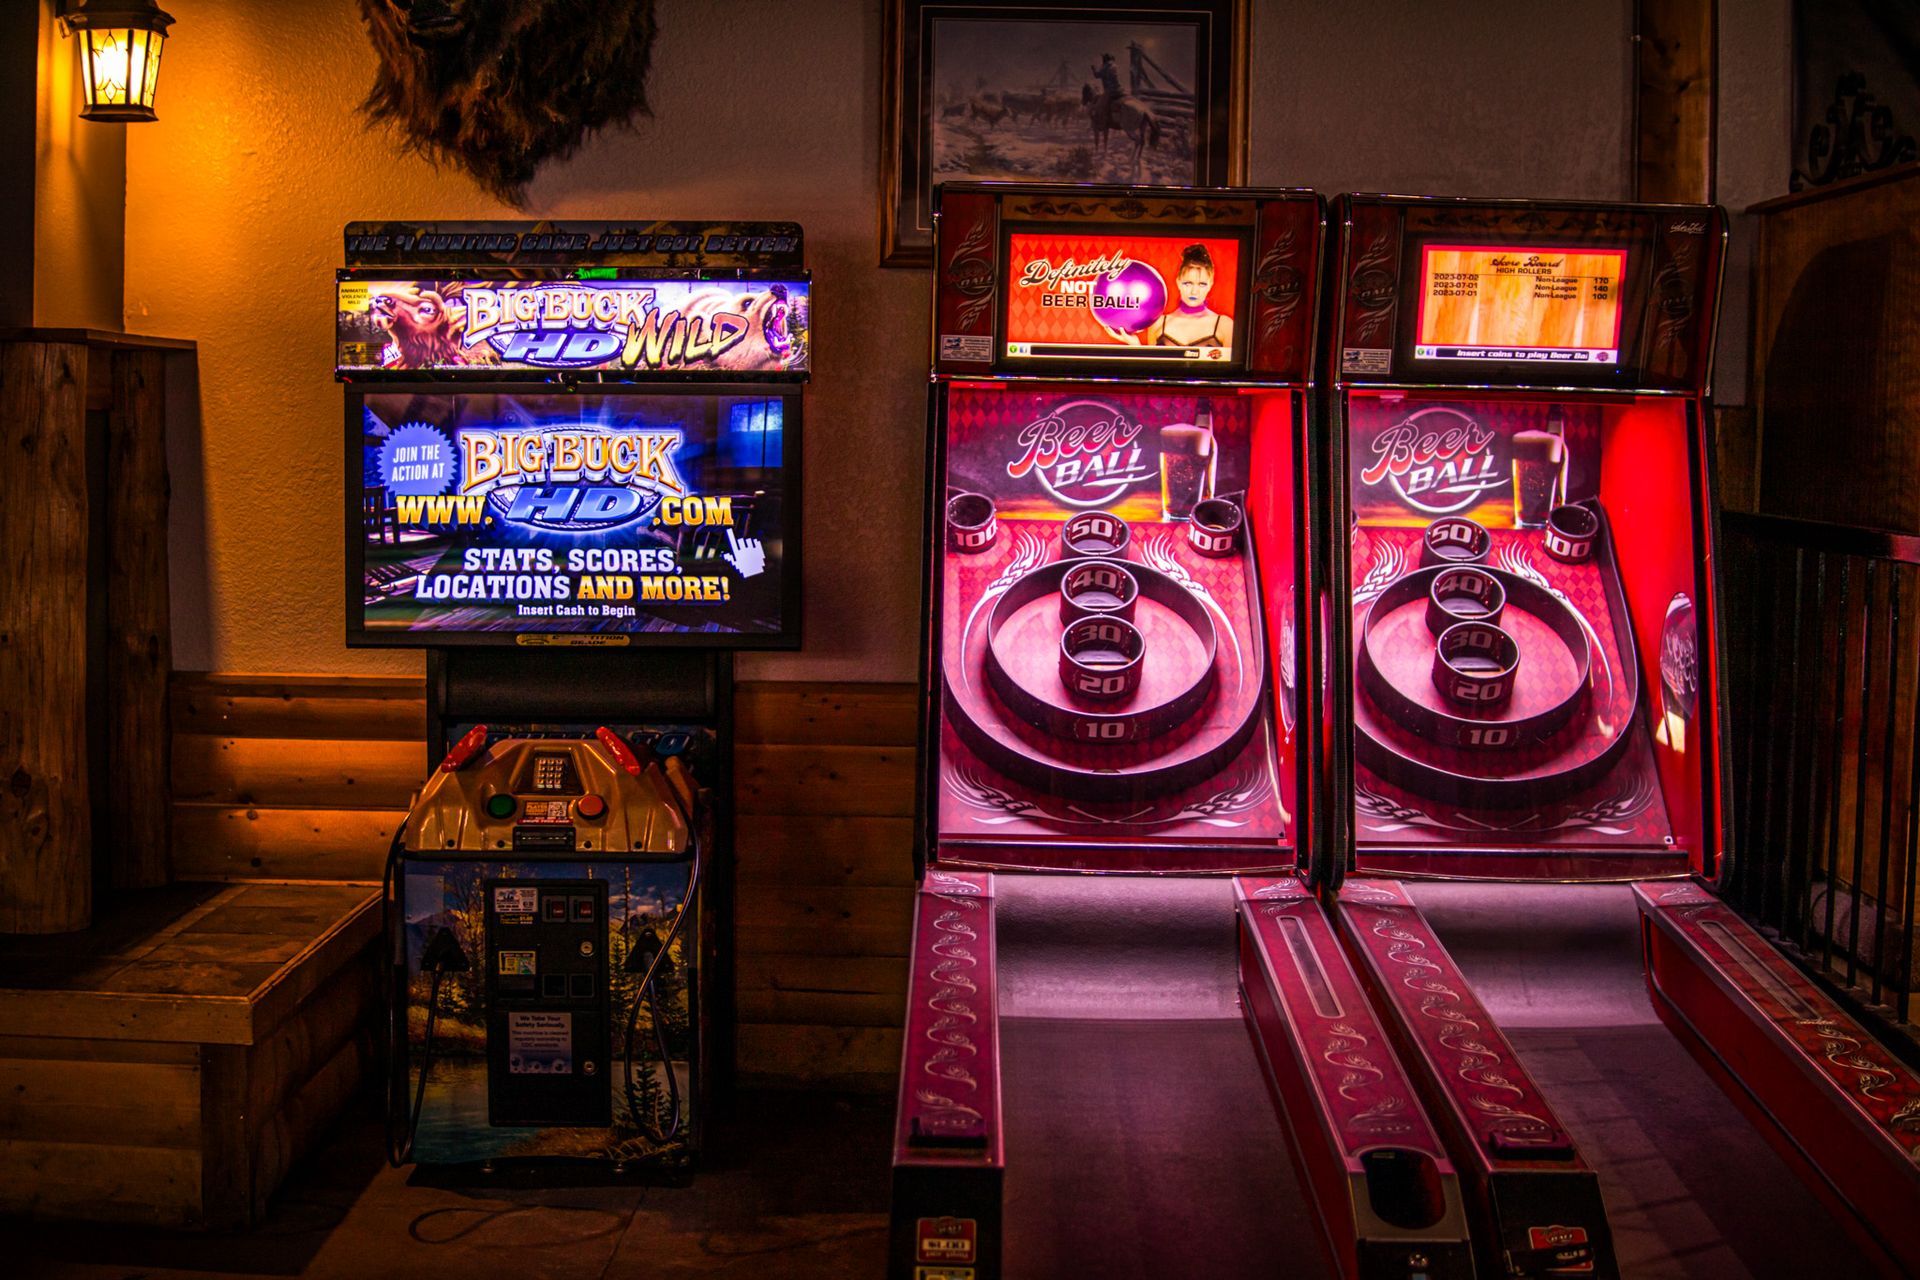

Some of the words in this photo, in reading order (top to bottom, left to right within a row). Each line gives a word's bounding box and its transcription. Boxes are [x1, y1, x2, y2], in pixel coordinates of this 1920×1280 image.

[349, 235, 390, 251] THE
[418, 235, 517, 251] HUNTING
[521, 235, 588, 251] GAME
[591, 235, 651, 251] JUST
[655, 235, 704, 251] GOT
[705, 235, 800, 252] BETTER!
[1020, 248, 1130, 290] Definitely
[1495, 267, 1516, 275] HIGH
[1060, 280, 1098, 294] NOT
[1042, 294, 1087, 308] BEER
[1092, 295, 1140, 309] BALL!
[463, 289, 538, 344] BIG
[542, 288, 655, 331] BUCK
[502, 331, 622, 361] HD
[621, 307, 750, 369] WILD
[1456, 349, 1485, 358] Insert
[1487, 350, 1513, 359] coins
[1514, 351, 1526, 359] to
[1526, 351, 1549, 361] play
[1549, 351, 1573, 360] Beer
[392, 445, 415, 464] JOIN
[416, 443, 441, 461] THE
[1007, 411, 1144, 478] Beer
[1361, 420, 1496, 485] Beer
[391, 464, 431, 482] ACTION
[432, 462, 445, 480] AT
[460, 431, 546, 493] BIG
[552, 431, 685, 493] BUCK
[1054, 447, 1148, 488] BALL
[1406, 453, 1500, 496] BALL
[396, 494, 494, 526] WWW.
[503, 485, 643, 524] HD
[651, 495, 734, 526] .COM
[954, 523, 997, 548] 100
[1070, 518, 1115, 538] 50
[1190, 526, 1232, 552] 100
[1430, 523, 1473, 545] 50
[1546, 531, 1591, 558] 100
[463, 548, 560, 575] STATS,
[568, 548, 684, 575] SCORES,
[415, 575, 571, 600] LOCATIONS
[577, 576, 634, 601] AND
[640, 576, 731, 601] MORE!
[1071, 570, 1117, 589] 40
[1438, 574, 1483, 594] 40
[518, 604, 554, 617] Insert
[556, 604, 587, 617] Cash
[588, 605, 599, 617] to
[600, 604, 637, 619] Begin
[1077, 624, 1122, 645] 30
[1450, 630, 1493, 650] 30
[1078, 672, 1126, 694] 20
[1455, 680, 1503, 701] 20
[1085, 721, 1126, 739] 10
[1469, 728, 1508, 746] 10
